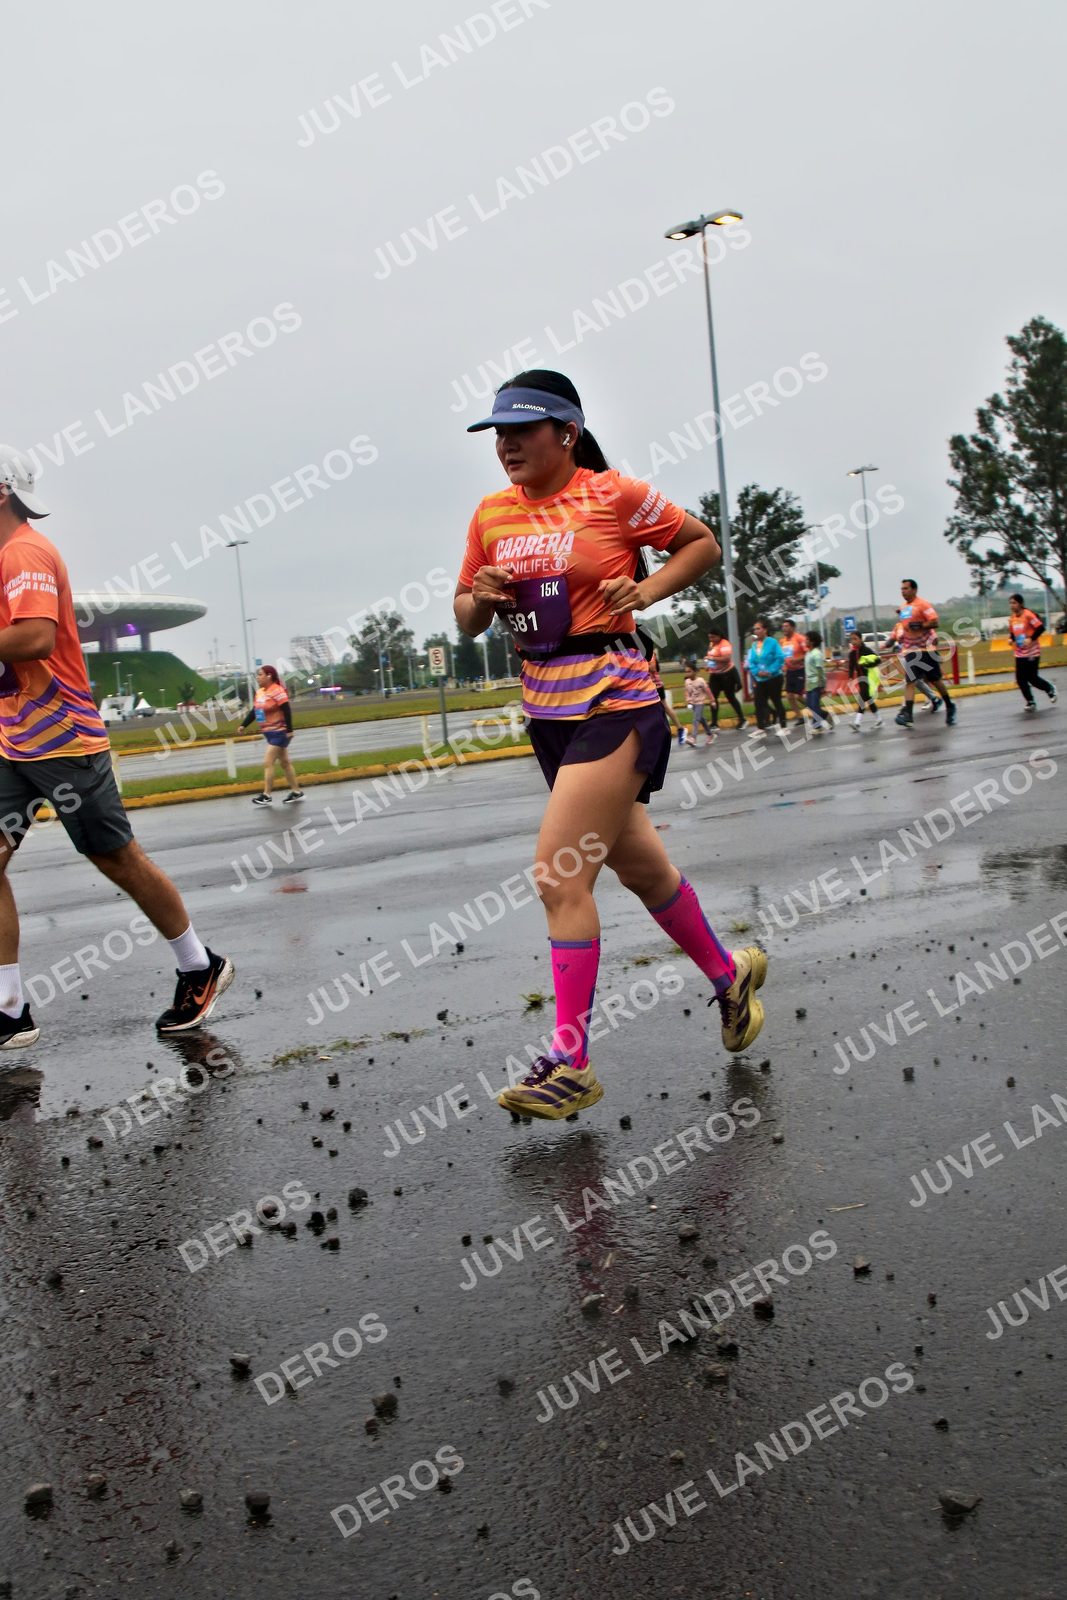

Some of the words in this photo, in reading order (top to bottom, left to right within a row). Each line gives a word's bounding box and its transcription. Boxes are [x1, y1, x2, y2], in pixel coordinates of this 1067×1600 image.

[512, 403, 546, 412] SALOMON
[496, 530, 575, 562] CARRERA
[540, 580, 559, 598] 15K
